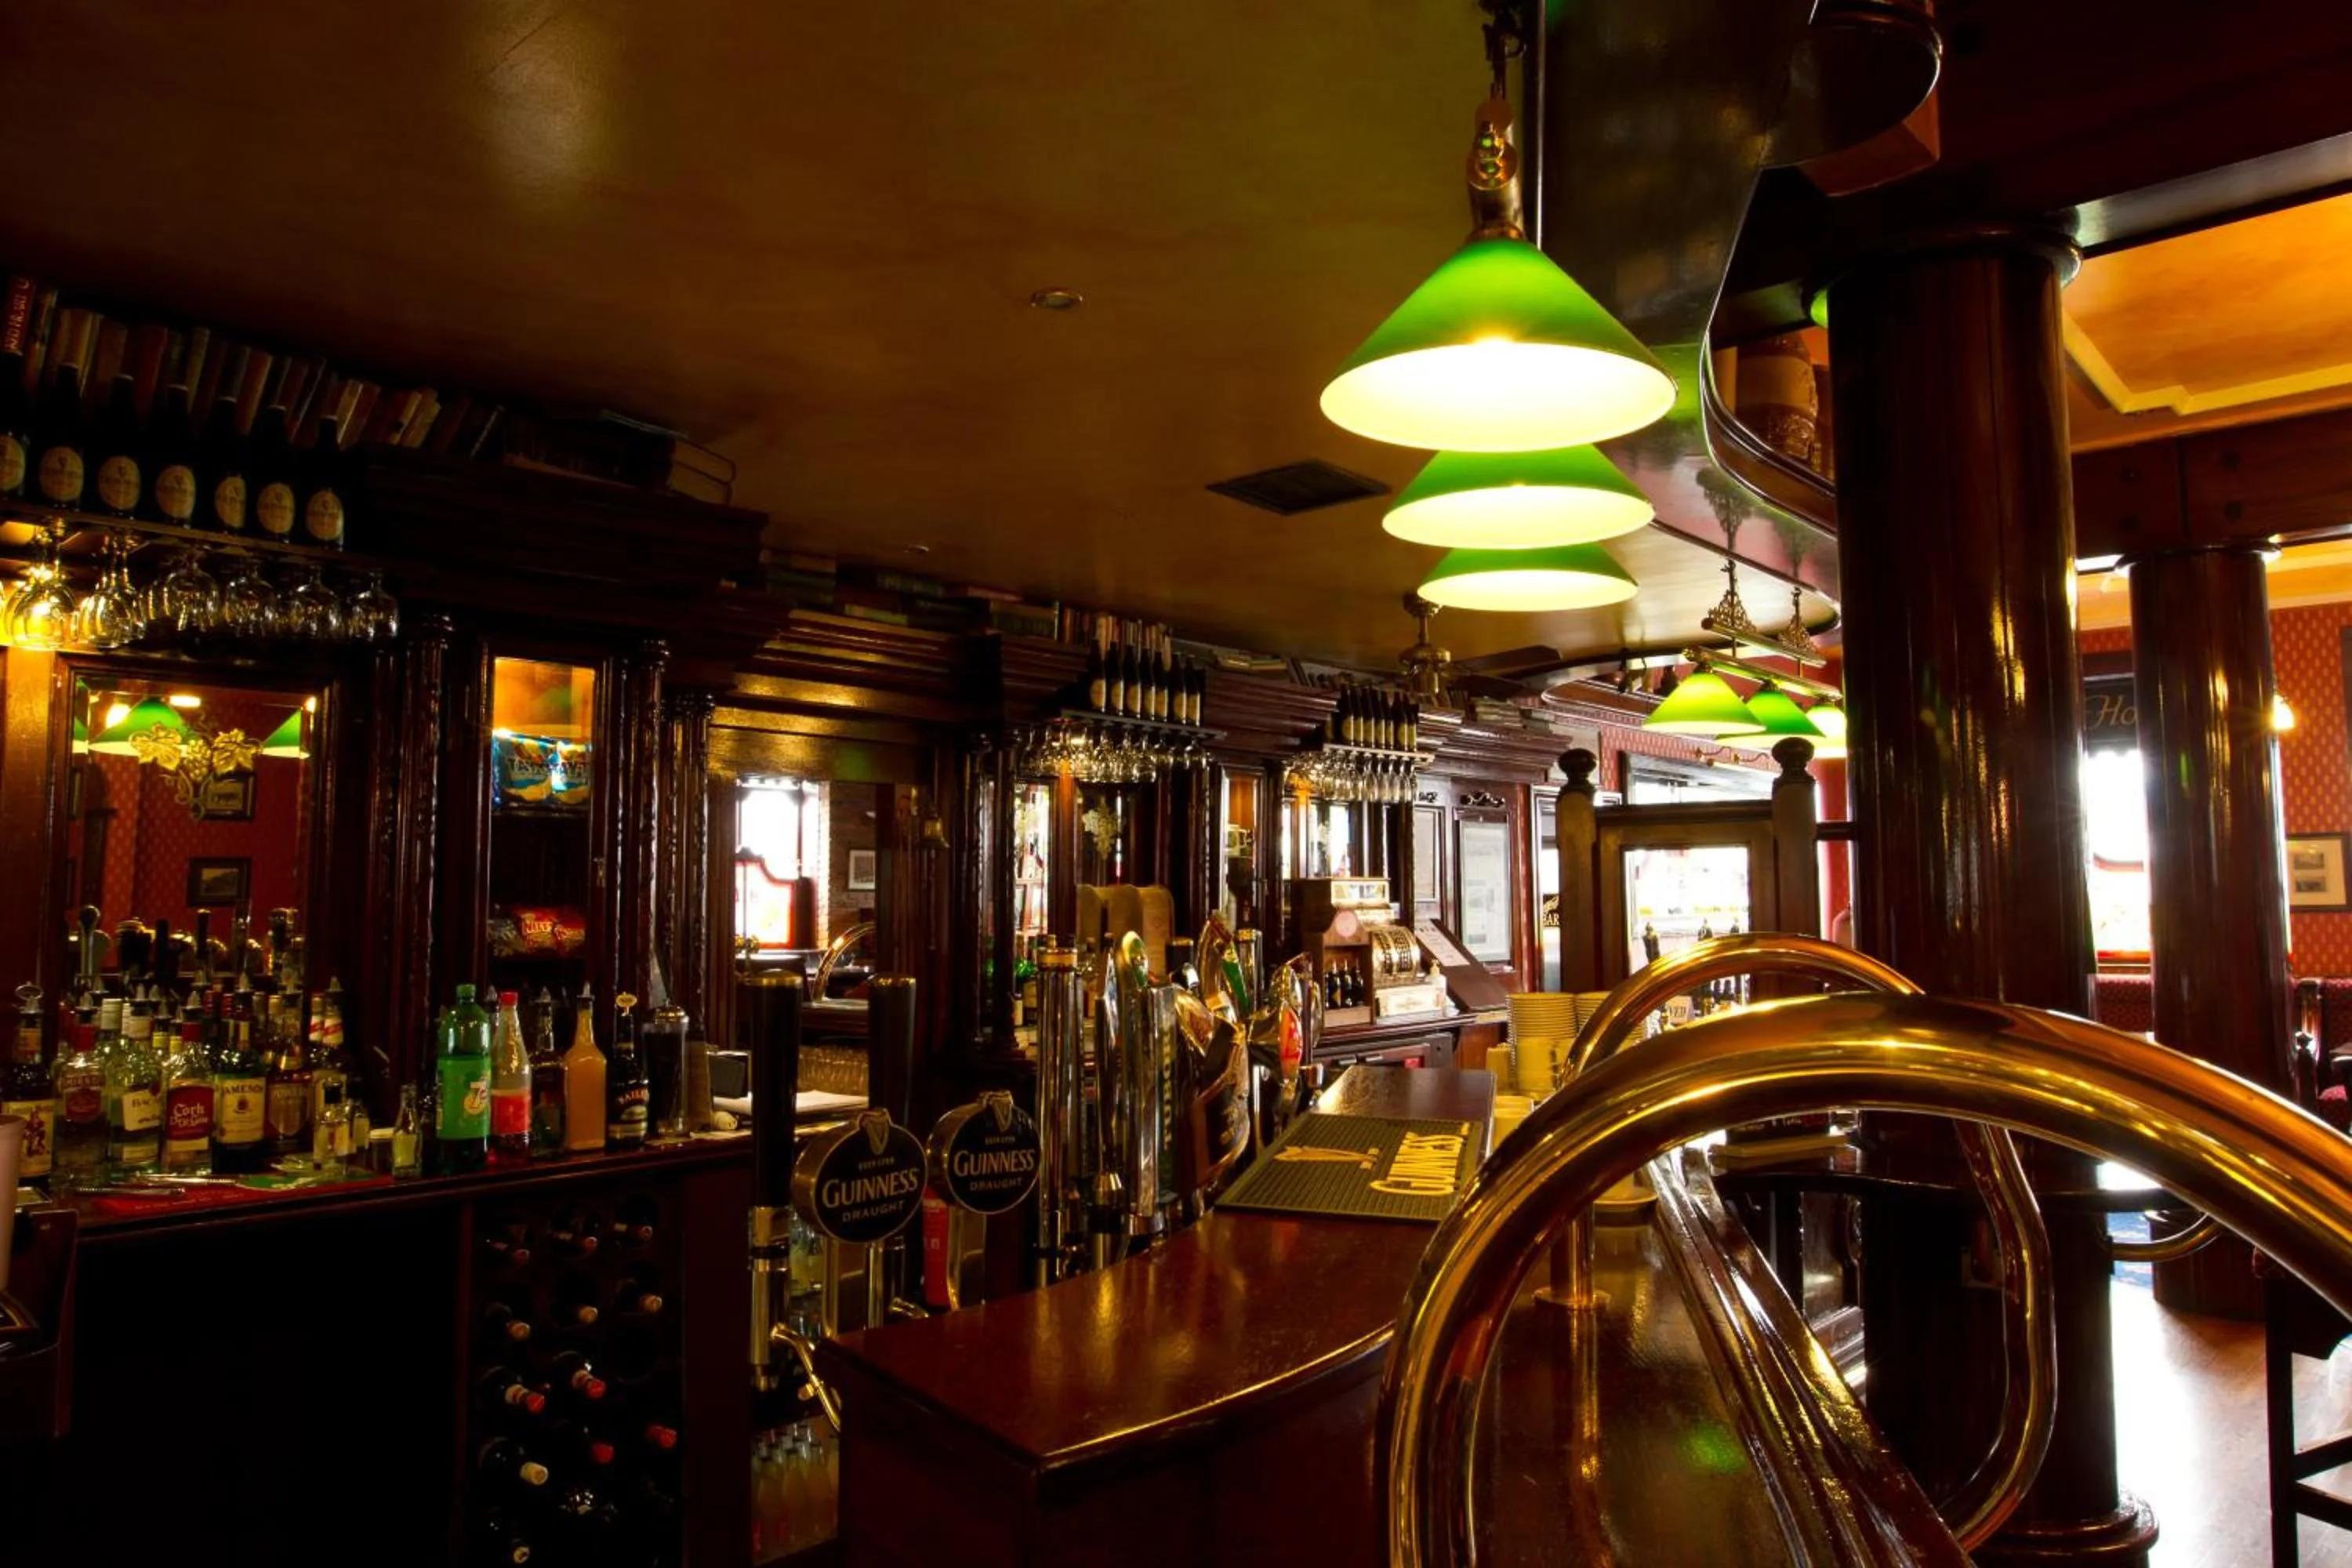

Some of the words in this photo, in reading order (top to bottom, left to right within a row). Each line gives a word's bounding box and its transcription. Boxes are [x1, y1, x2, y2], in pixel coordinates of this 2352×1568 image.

[220, 1084, 265, 1094] AMESON
[173, 1102, 205, 1117] Cork
[953, 1149, 1036, 1177] GUINNESS
[822, 1168, 919, 1208] GUINNESS
[969, 1177, 1023, 1192] DRAUGHT
[841, 1200, 906, 1223] DRAUGHT
